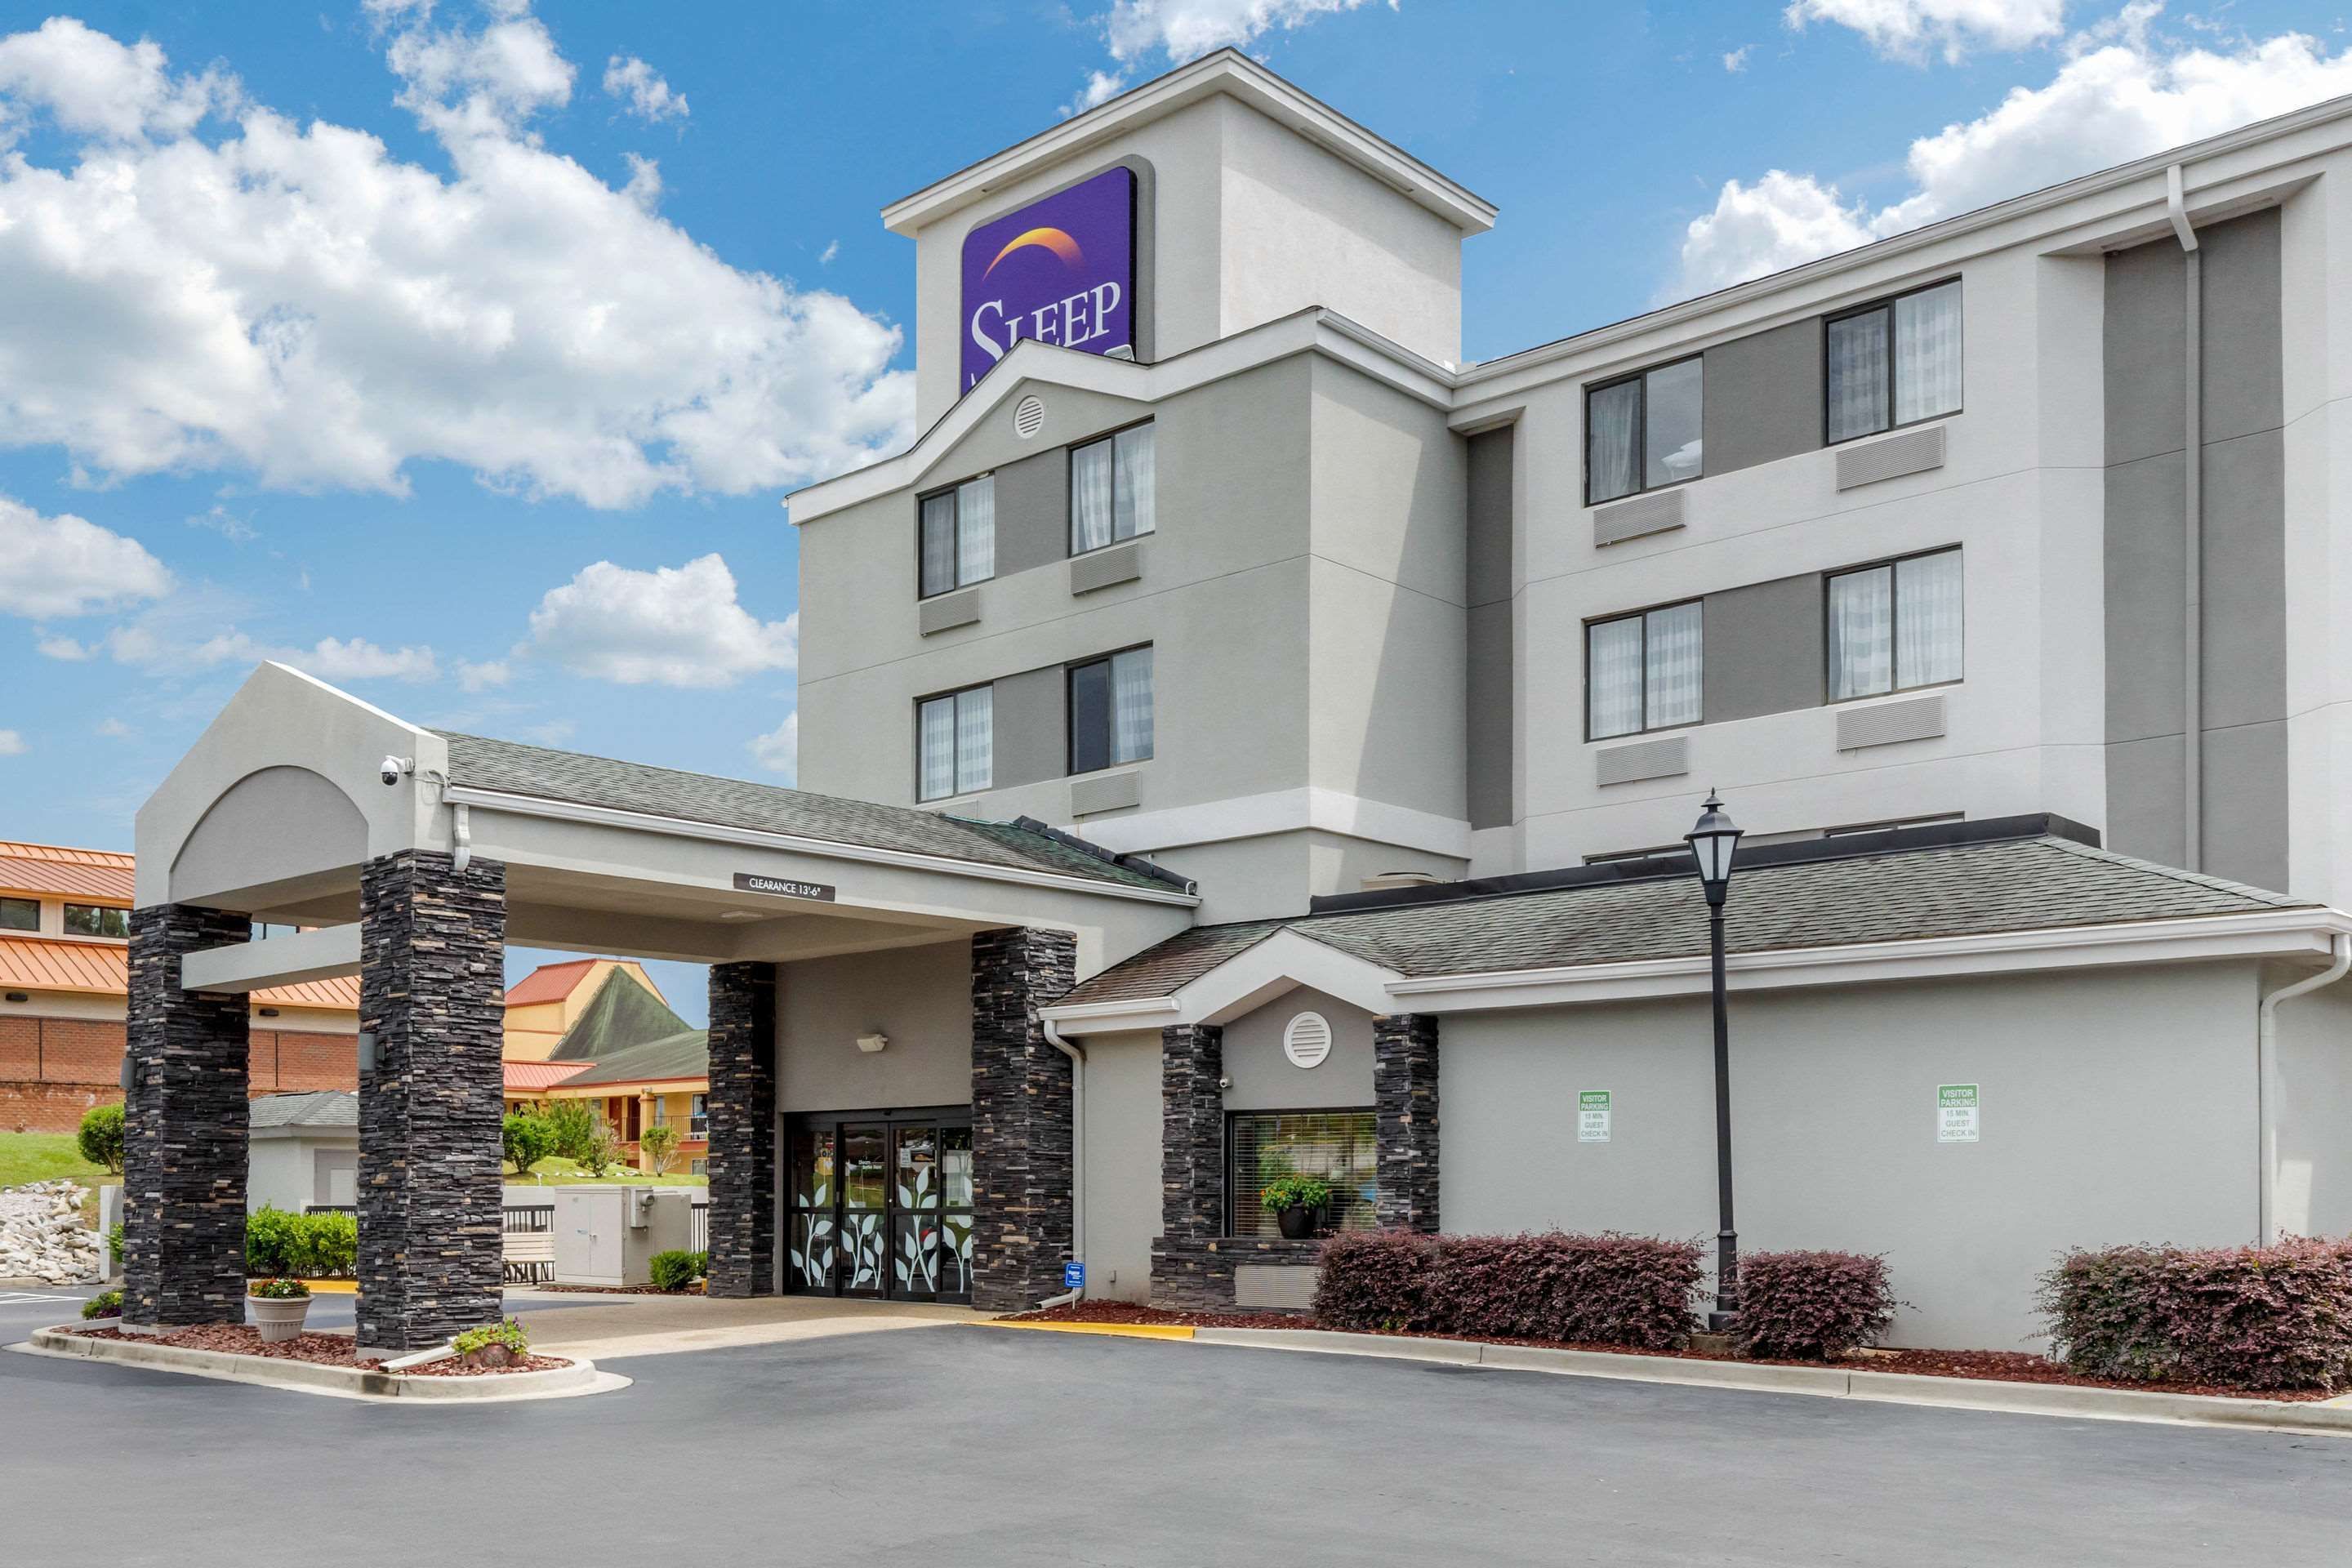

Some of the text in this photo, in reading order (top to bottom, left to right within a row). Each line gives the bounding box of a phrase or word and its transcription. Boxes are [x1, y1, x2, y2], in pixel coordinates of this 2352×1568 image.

[971, 281, 1120, 362] SLEEP
[749, 878, 796, 893] CLEARANCE
[1582, 1094, 1607, 1102] VISITOR
[1942, 1089, 1974, 1098] VISITOR
[1581, 1102, 1609, 1111] PARKING
[1940, 1098, 1976, 1107] PARKING
[1946, 1110, 1954, 1118] 15
[1945, 1120, 1971, 1128] GUEST
[1940, 1129, 1966, 1138] CHECK
